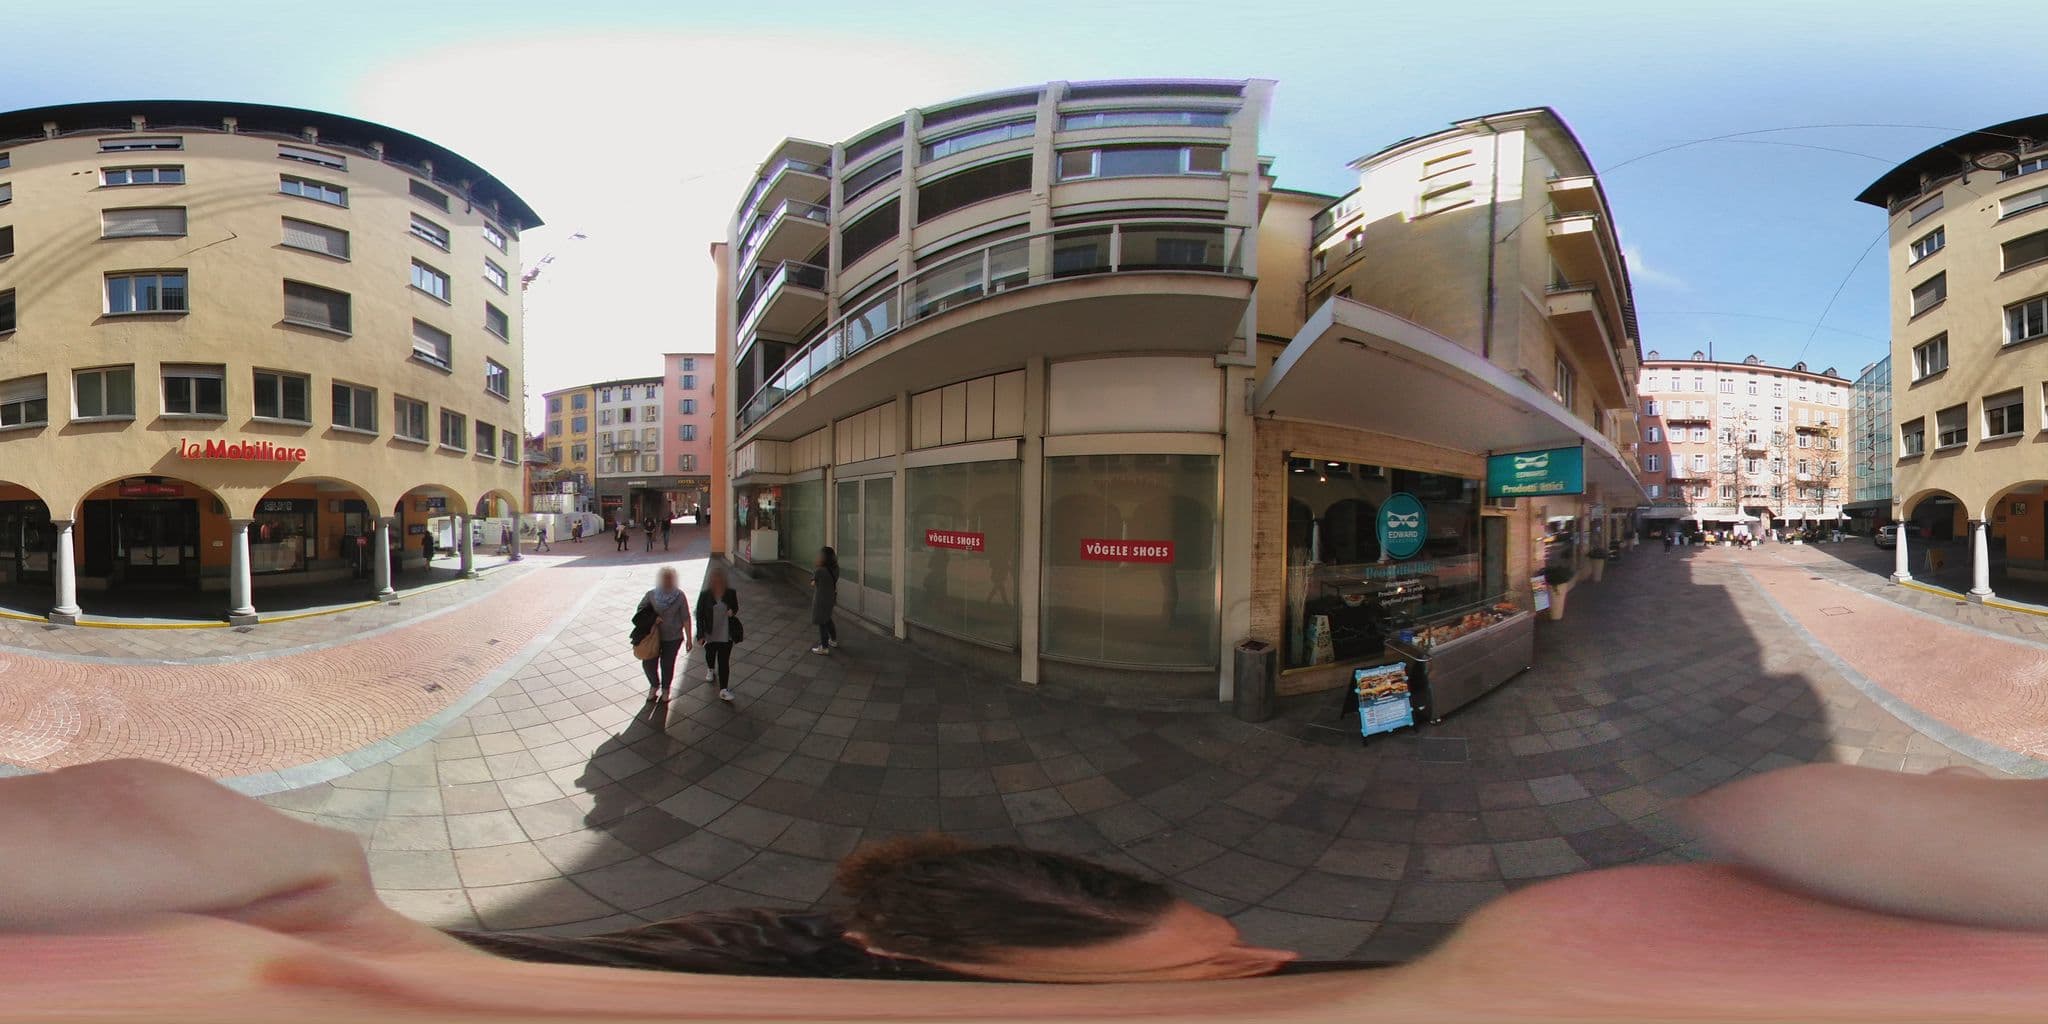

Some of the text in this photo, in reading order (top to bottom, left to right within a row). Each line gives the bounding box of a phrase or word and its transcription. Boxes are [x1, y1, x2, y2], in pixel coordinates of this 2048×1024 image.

[181, 438, 306, 461] la Mobiliare
[929, 533, 981, 546] VÖGELE SHOES
[1086, 543, 1168, 556] VÖGELE SHOES
